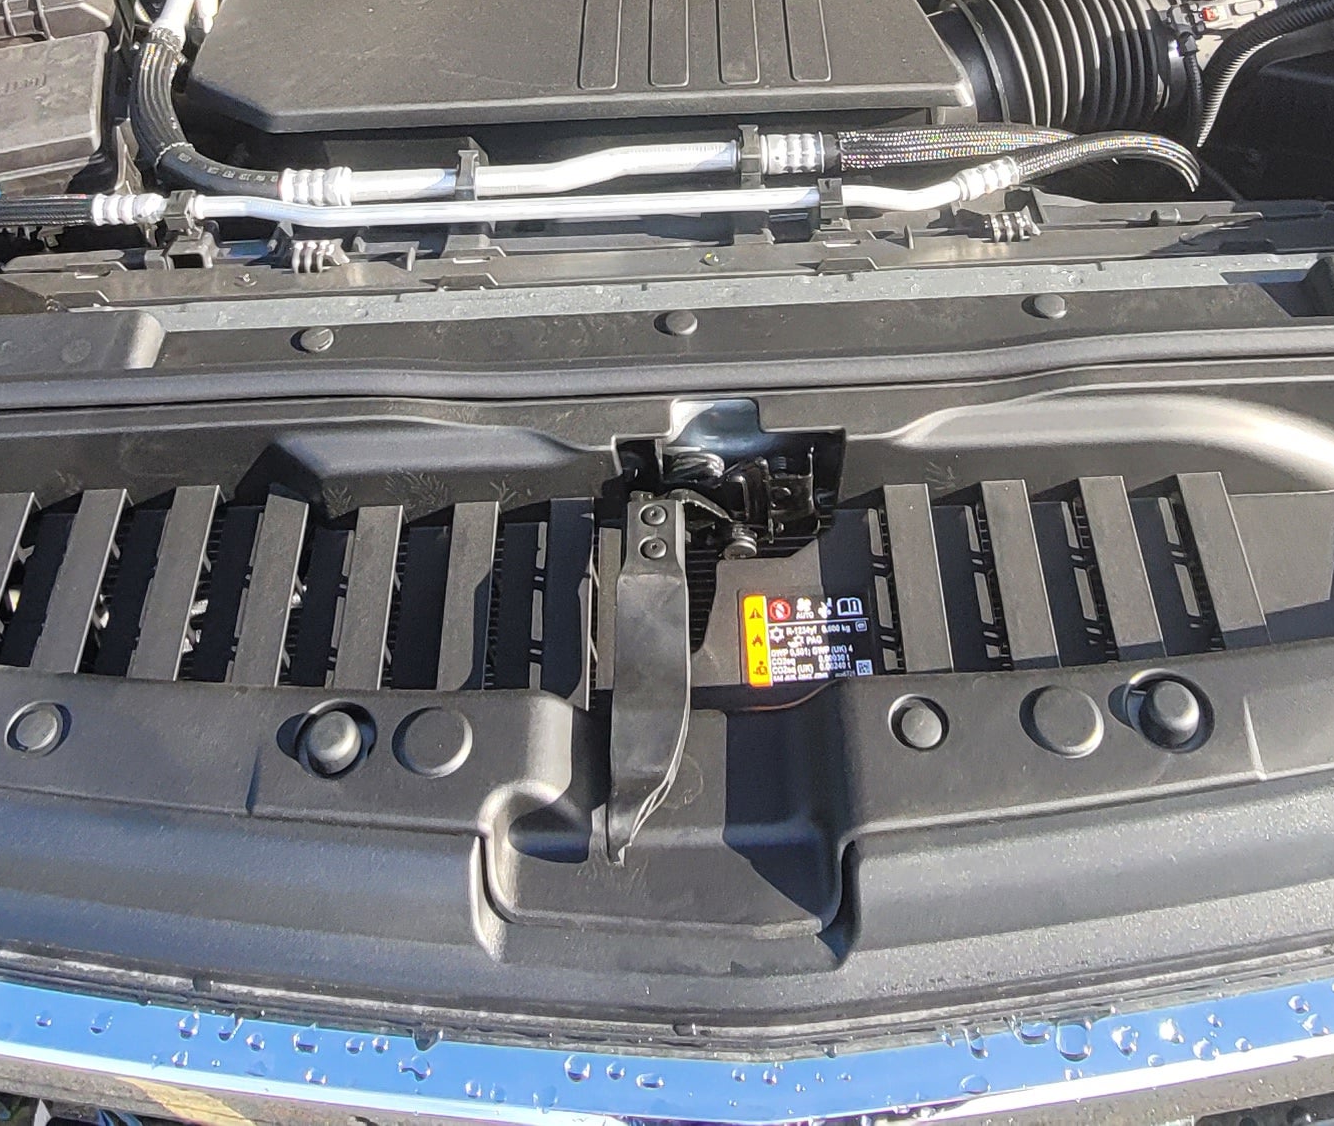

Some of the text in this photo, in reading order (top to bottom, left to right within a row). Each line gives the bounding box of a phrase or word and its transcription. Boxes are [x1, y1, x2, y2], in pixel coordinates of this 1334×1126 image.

[796, 611, 814, 620] AUTO
[841, 624, 851, 633] kg
[831, 645, 847, 654] (UK)
[797, 664, 814, 675] (UK)
